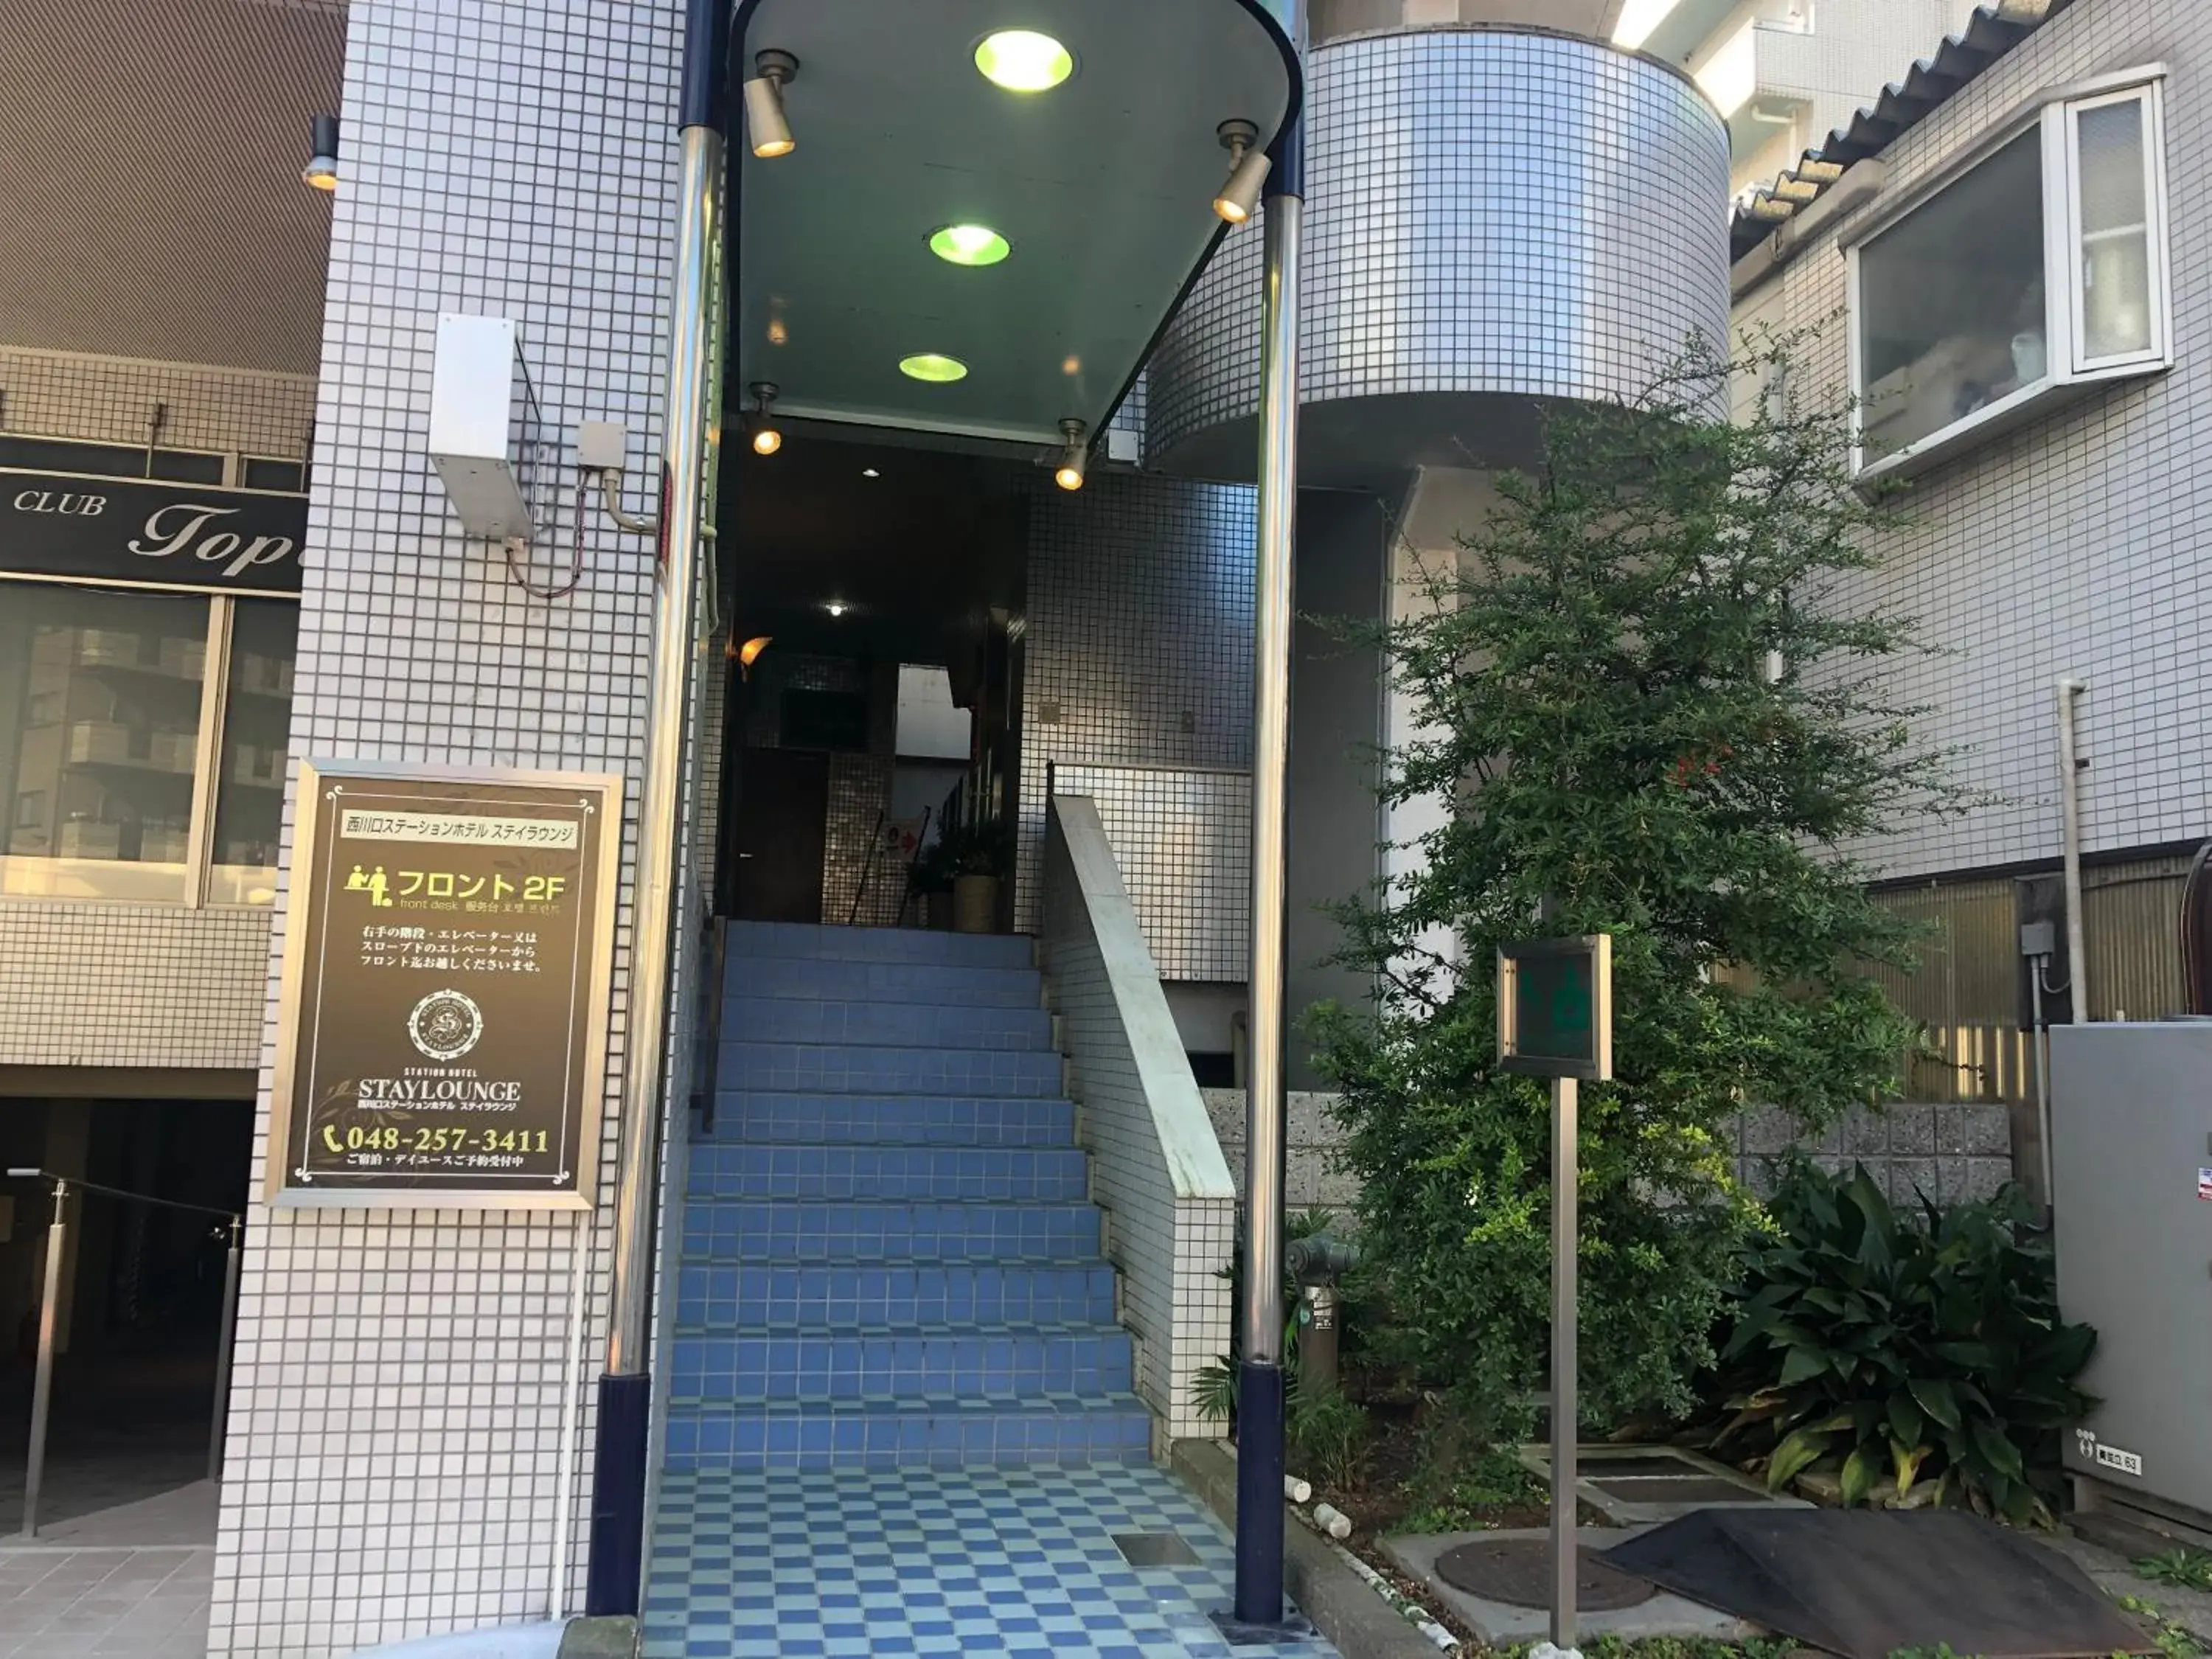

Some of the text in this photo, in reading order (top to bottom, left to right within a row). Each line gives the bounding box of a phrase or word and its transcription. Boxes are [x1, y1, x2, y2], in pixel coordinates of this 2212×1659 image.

[14, 490, 107, 516] CLUB
[128, 504, 305, 577] Top
[347, 815, 574, 842] 西川口ステーションホテル ステイラウンジ
[398, 871, 566, 900] フロント 2F
[400, 899, 458, 911] front desk
[404, 1068, 445, 1077] STATION
[358, 1079, 521, 1101] STAYLOUNGE
[347, 1126, 549, 1152] 048-257-3411
